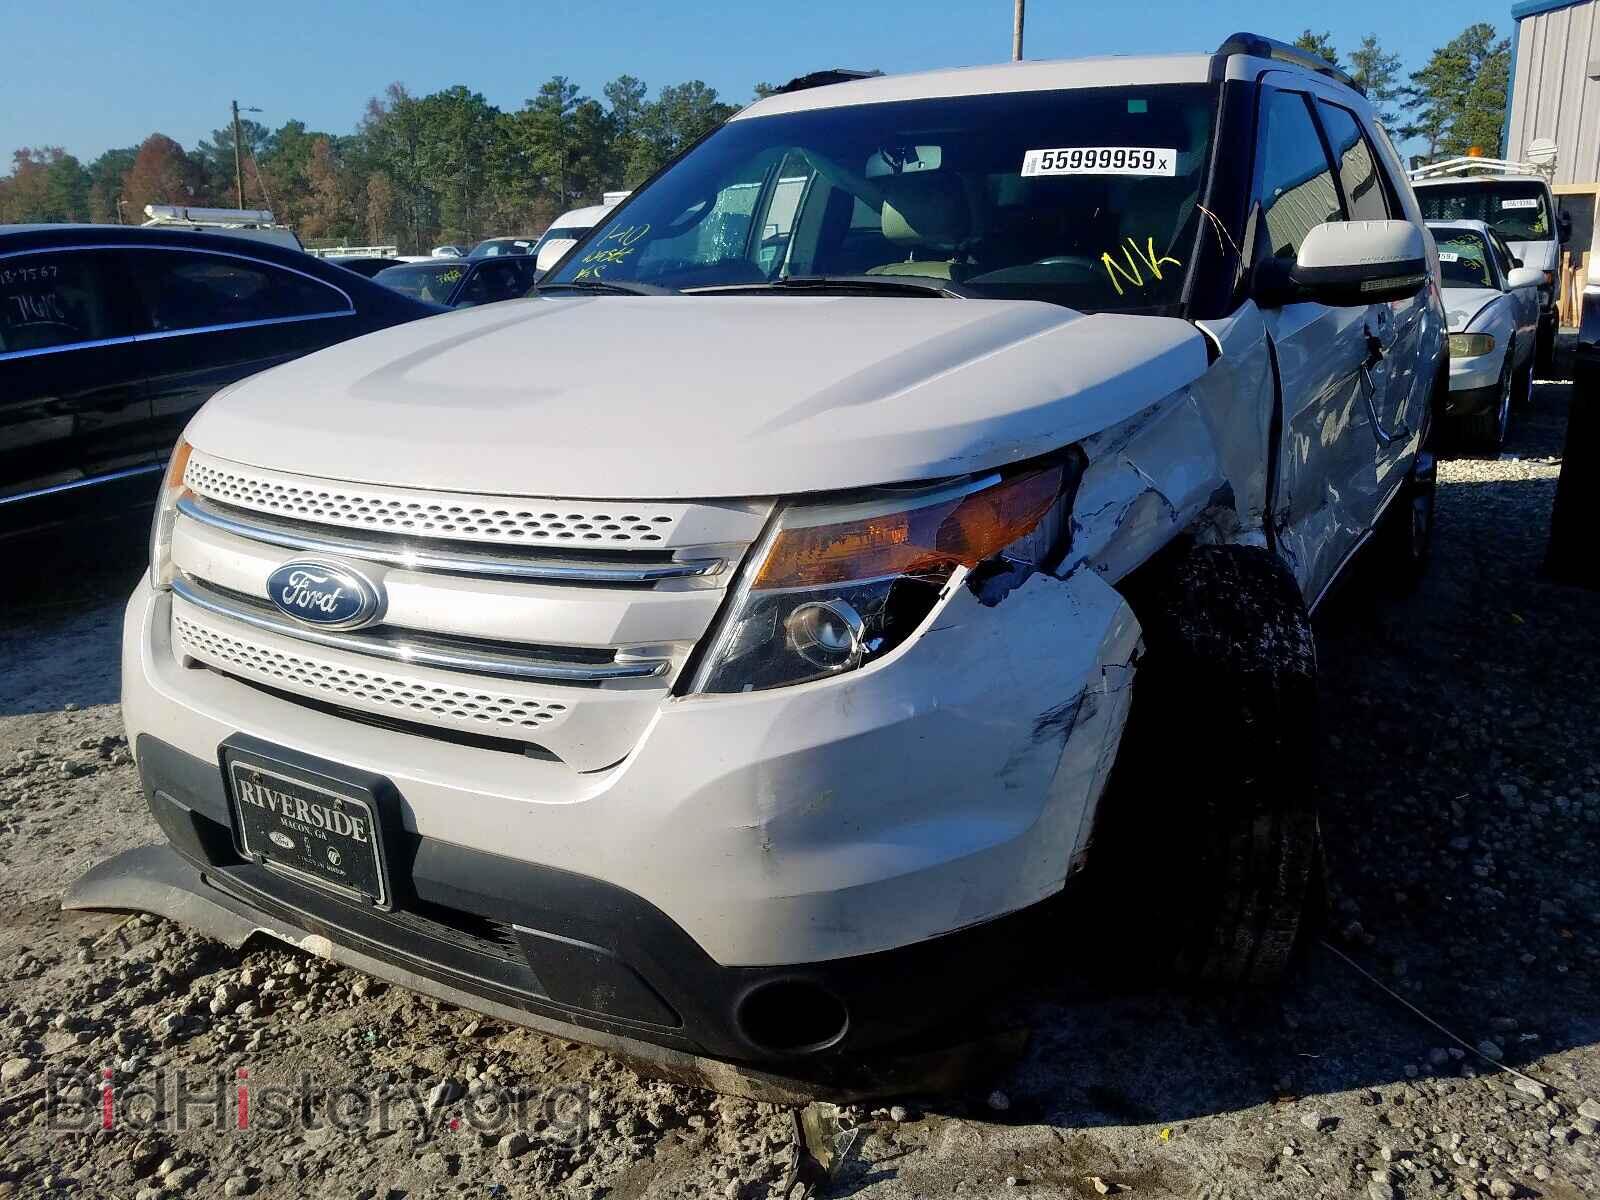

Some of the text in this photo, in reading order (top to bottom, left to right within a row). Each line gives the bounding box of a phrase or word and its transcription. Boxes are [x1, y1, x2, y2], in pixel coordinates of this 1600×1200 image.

[1041, 149, 1155, 170] 55999959
[282, 570, 344, 613] Ford
[240, 780, 368, 843] RIVERSIDE
